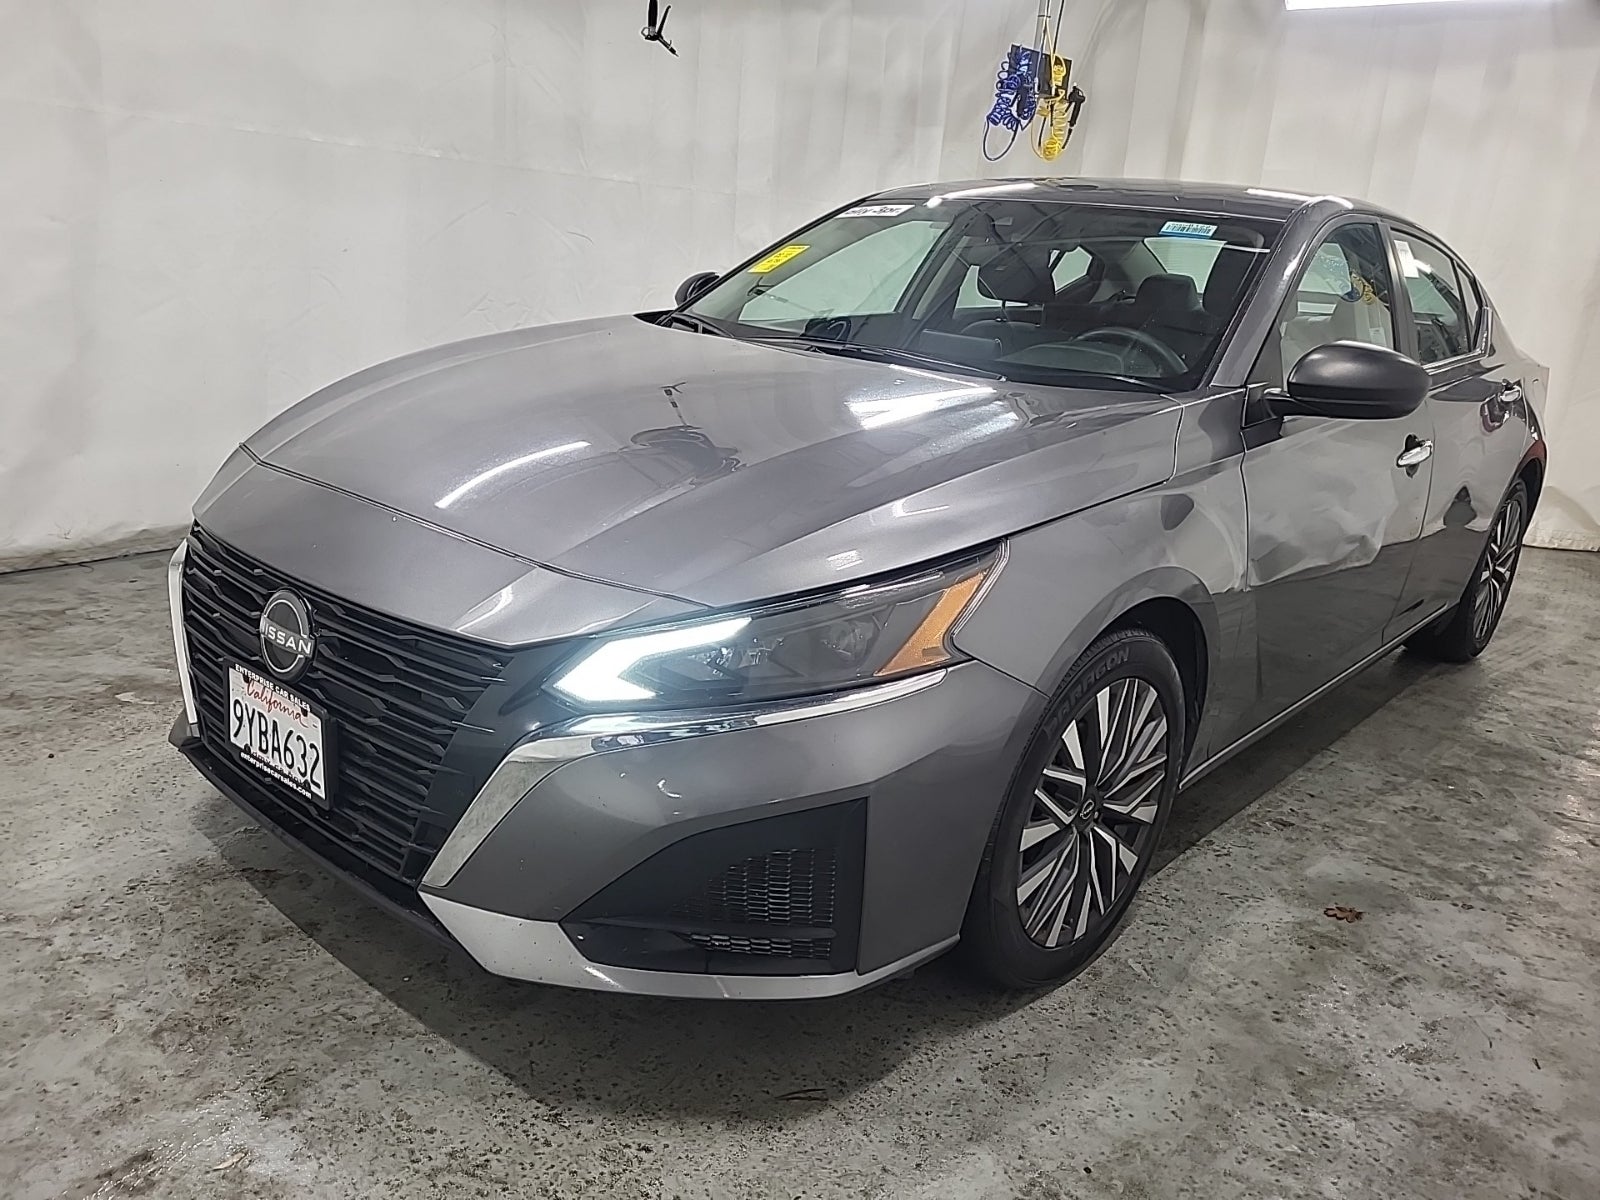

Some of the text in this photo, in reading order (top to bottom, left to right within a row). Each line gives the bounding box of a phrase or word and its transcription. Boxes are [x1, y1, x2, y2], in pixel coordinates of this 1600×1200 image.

[260, 615, 312, 655] NISSAN
[235, 663, 311, 712] ENTERPRISE CAR SALES
[246, 679, 308, 729] California
[233, 698, 321, 790] 9YBA632
[240, 752, 312, 799] enterprisecarsales.com
